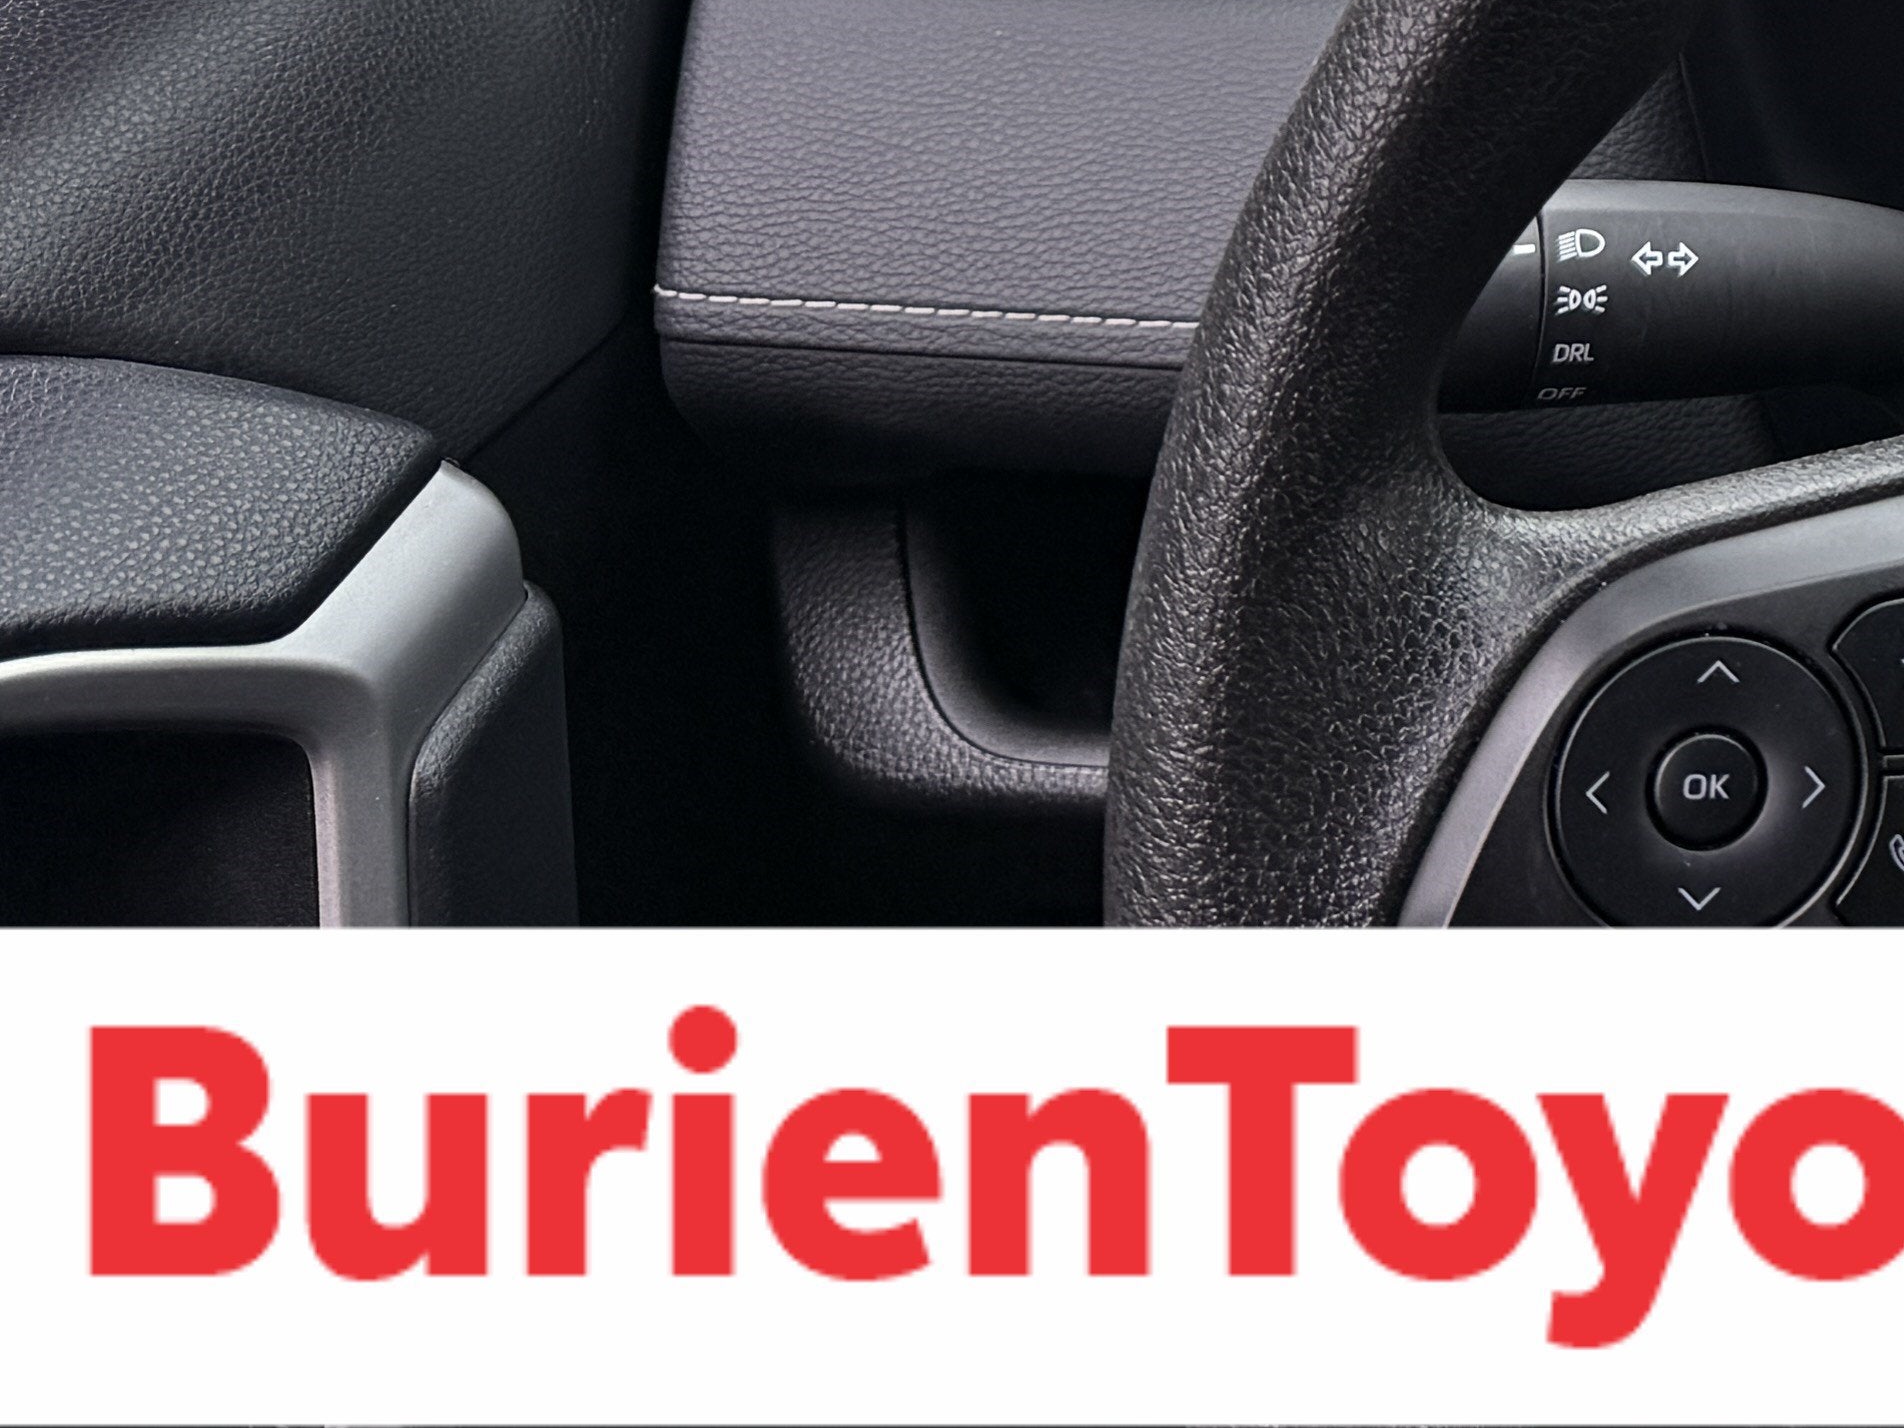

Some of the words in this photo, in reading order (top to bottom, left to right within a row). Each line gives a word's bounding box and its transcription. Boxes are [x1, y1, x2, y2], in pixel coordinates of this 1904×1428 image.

[1551, 342, 1595, 365] DRL
[1537, 386, 1588, 402] OFF
[1682, 773, 1731, 801] OK
